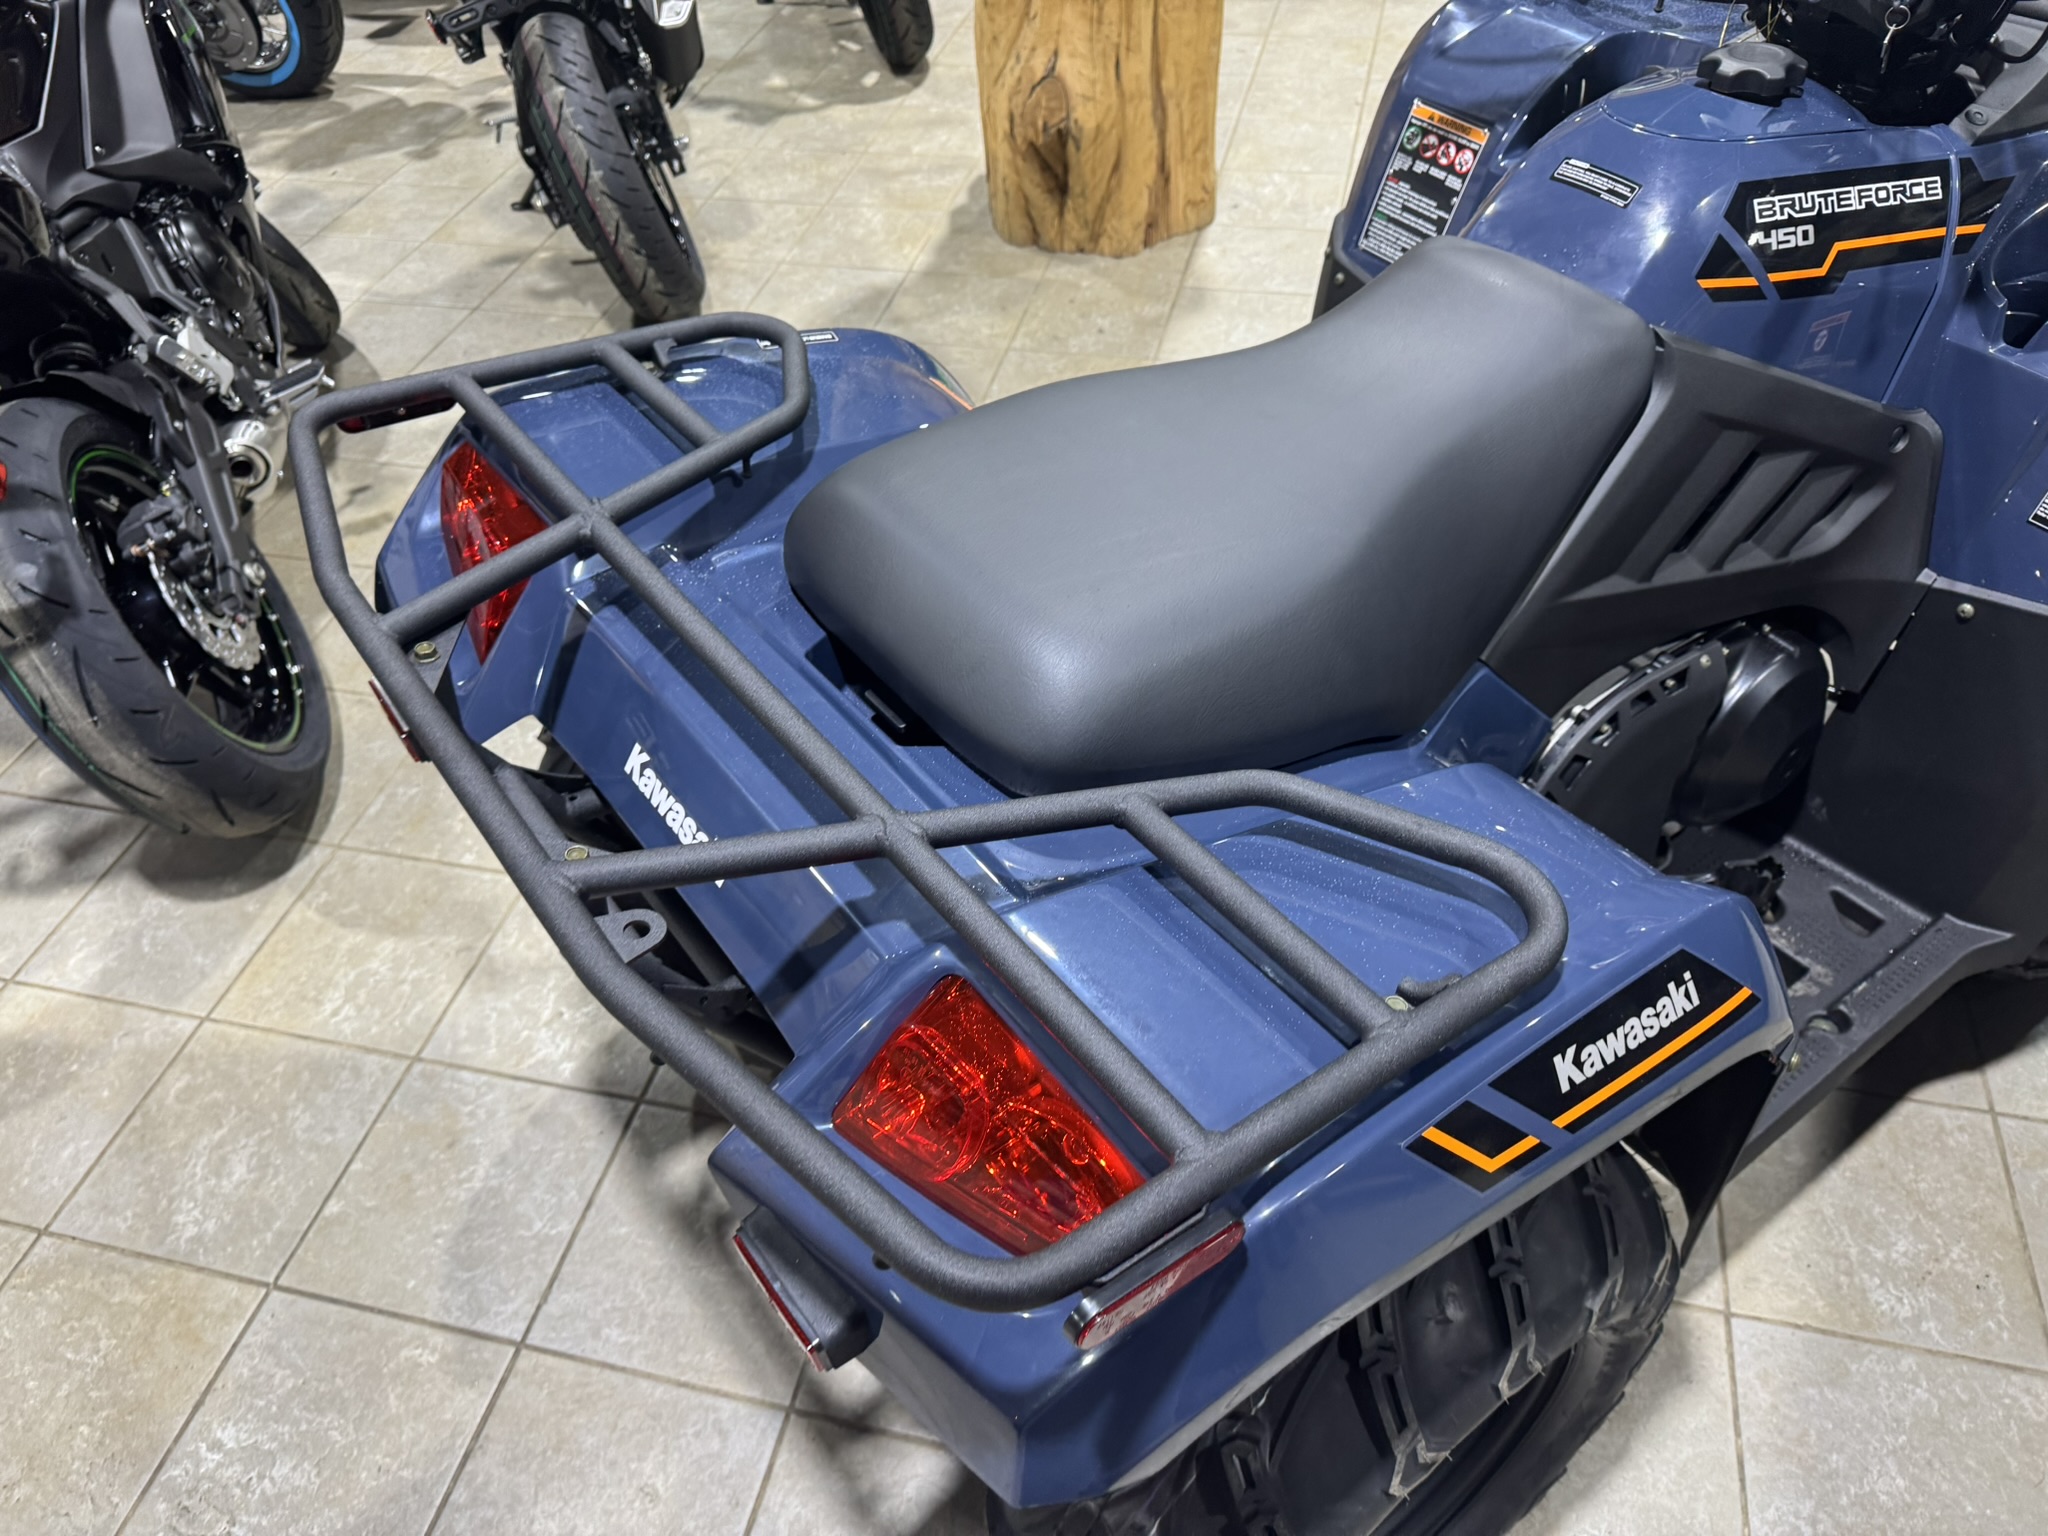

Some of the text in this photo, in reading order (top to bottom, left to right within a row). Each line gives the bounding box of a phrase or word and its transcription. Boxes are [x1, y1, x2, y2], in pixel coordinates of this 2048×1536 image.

[1757, 224, 1815, 250] 450
[624, 742, 725, 888] Kawas
[1552, 970, 1701, 1094] Kawasaki
